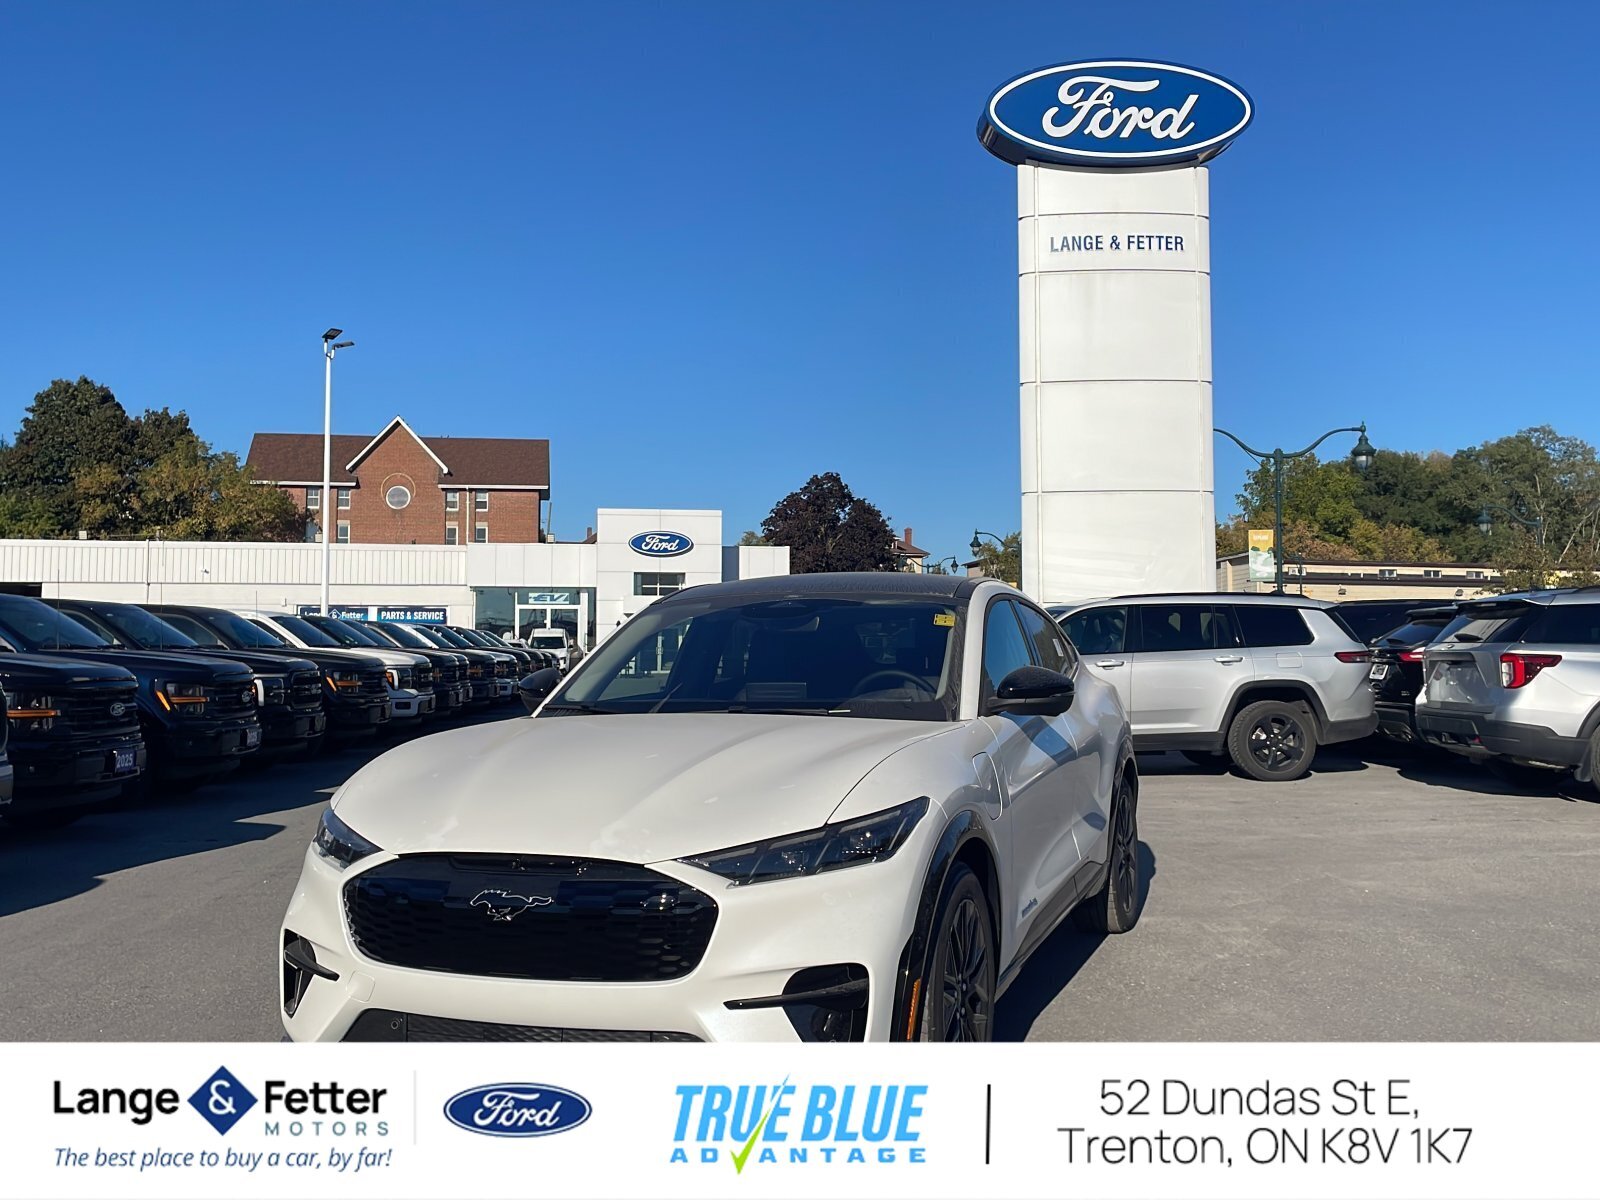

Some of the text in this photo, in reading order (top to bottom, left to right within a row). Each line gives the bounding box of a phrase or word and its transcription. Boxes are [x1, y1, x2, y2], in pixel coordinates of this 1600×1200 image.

[1041, 75, 1200, 140] Ford
[1049, 235, 1185, 253] LANGE & FETTER
[641, 534, 680, 551] Ford
[381, 611, 444, 620] PARTS & SERVICE
[116, 753, 133, 768] 2025
